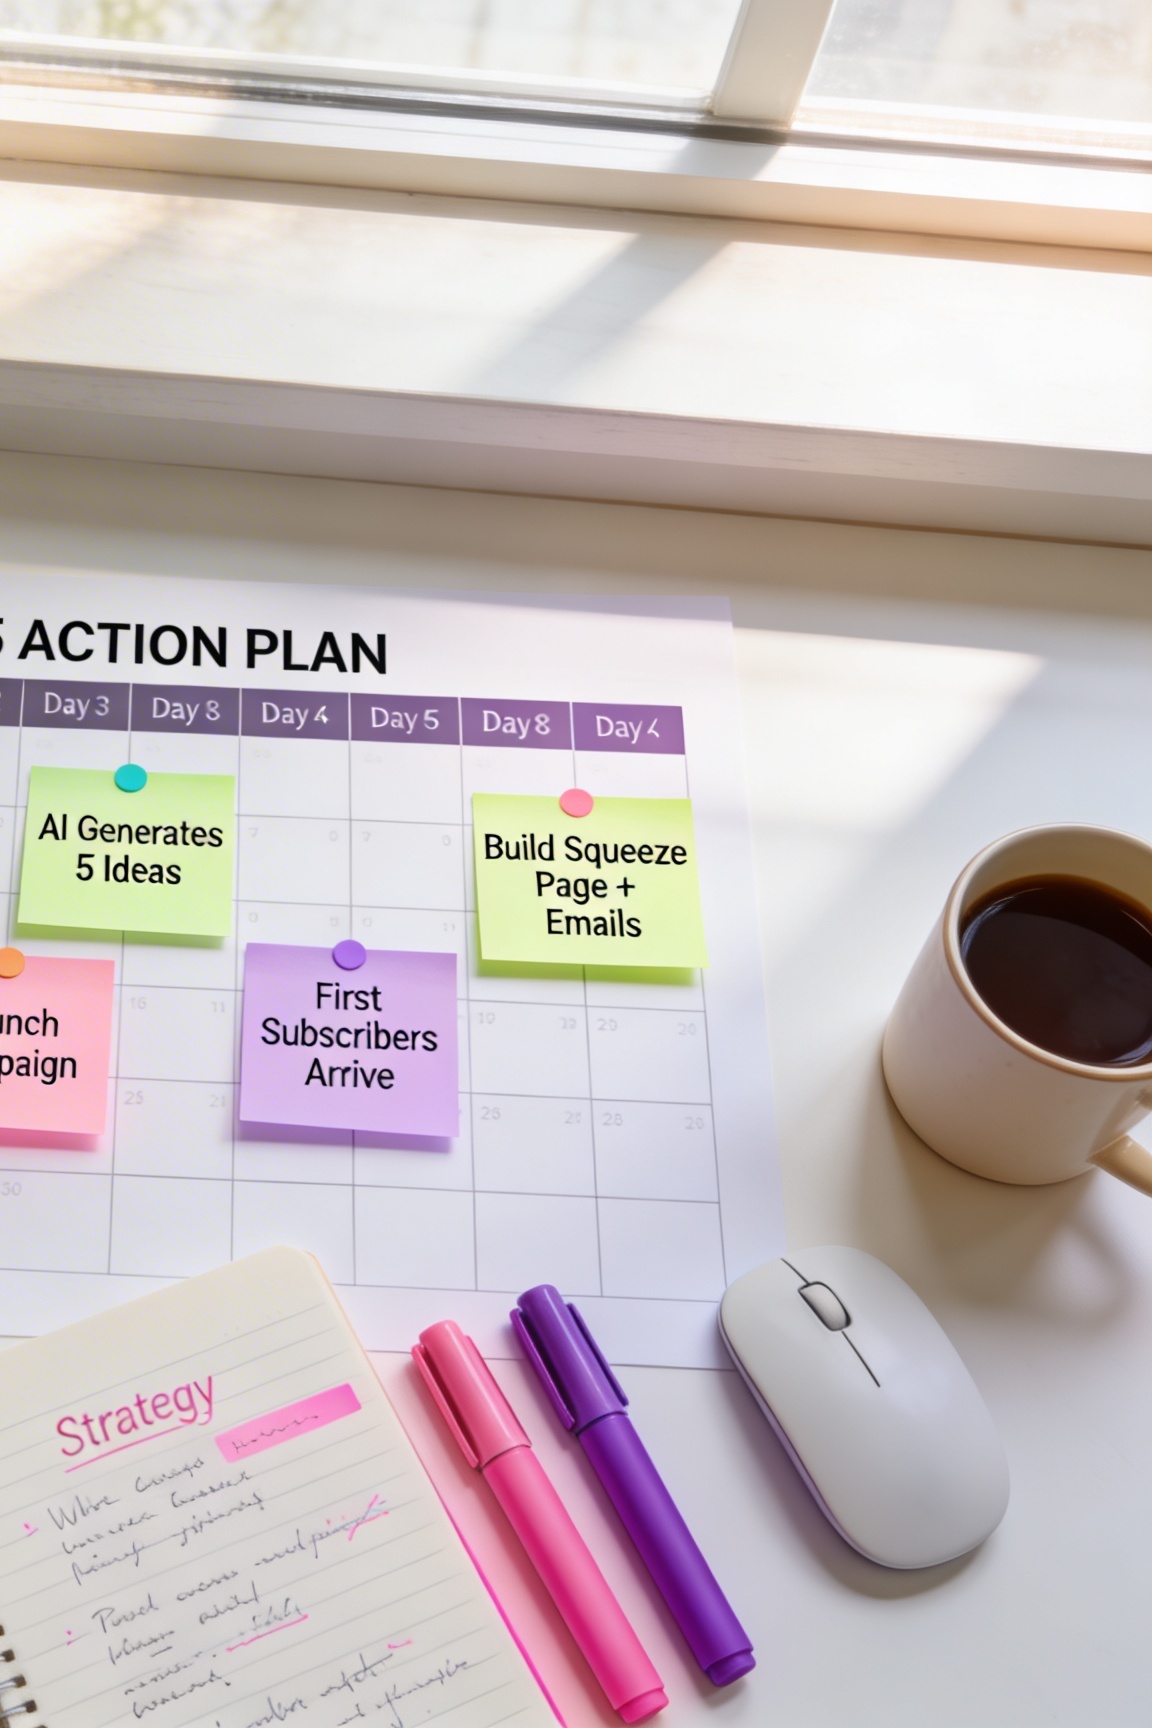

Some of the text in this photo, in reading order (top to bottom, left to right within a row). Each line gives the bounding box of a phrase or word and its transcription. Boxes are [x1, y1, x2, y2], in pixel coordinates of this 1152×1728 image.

[17, 618, 227, 668] ACTION
[246, 628, 387, 675] PLAN
[44, 691, 110, 719] Day 3
[152, 697, 200, 725] Day
[262, 701, 309, 729] Day
[371, 706, 440, 733] Day 5
[482, 709, 551, 738] Day 8
[595, 715, 643, 743] Day
[37, 812, 223, 848] AI Generates
[484, 832, 688, 870] Build Squeeze
[75, 853, 182, 885] 5 Ideas
[535, 870, 636, 906] Page +
[546, 908, 642, 938] Emails
[316, 981, 383, 1012] First
[261, 1017, 438, 1052] Subscribers
[304, 1057, 395, 1090] Arrive
[56, 1375, 214, 1457] Strategy
